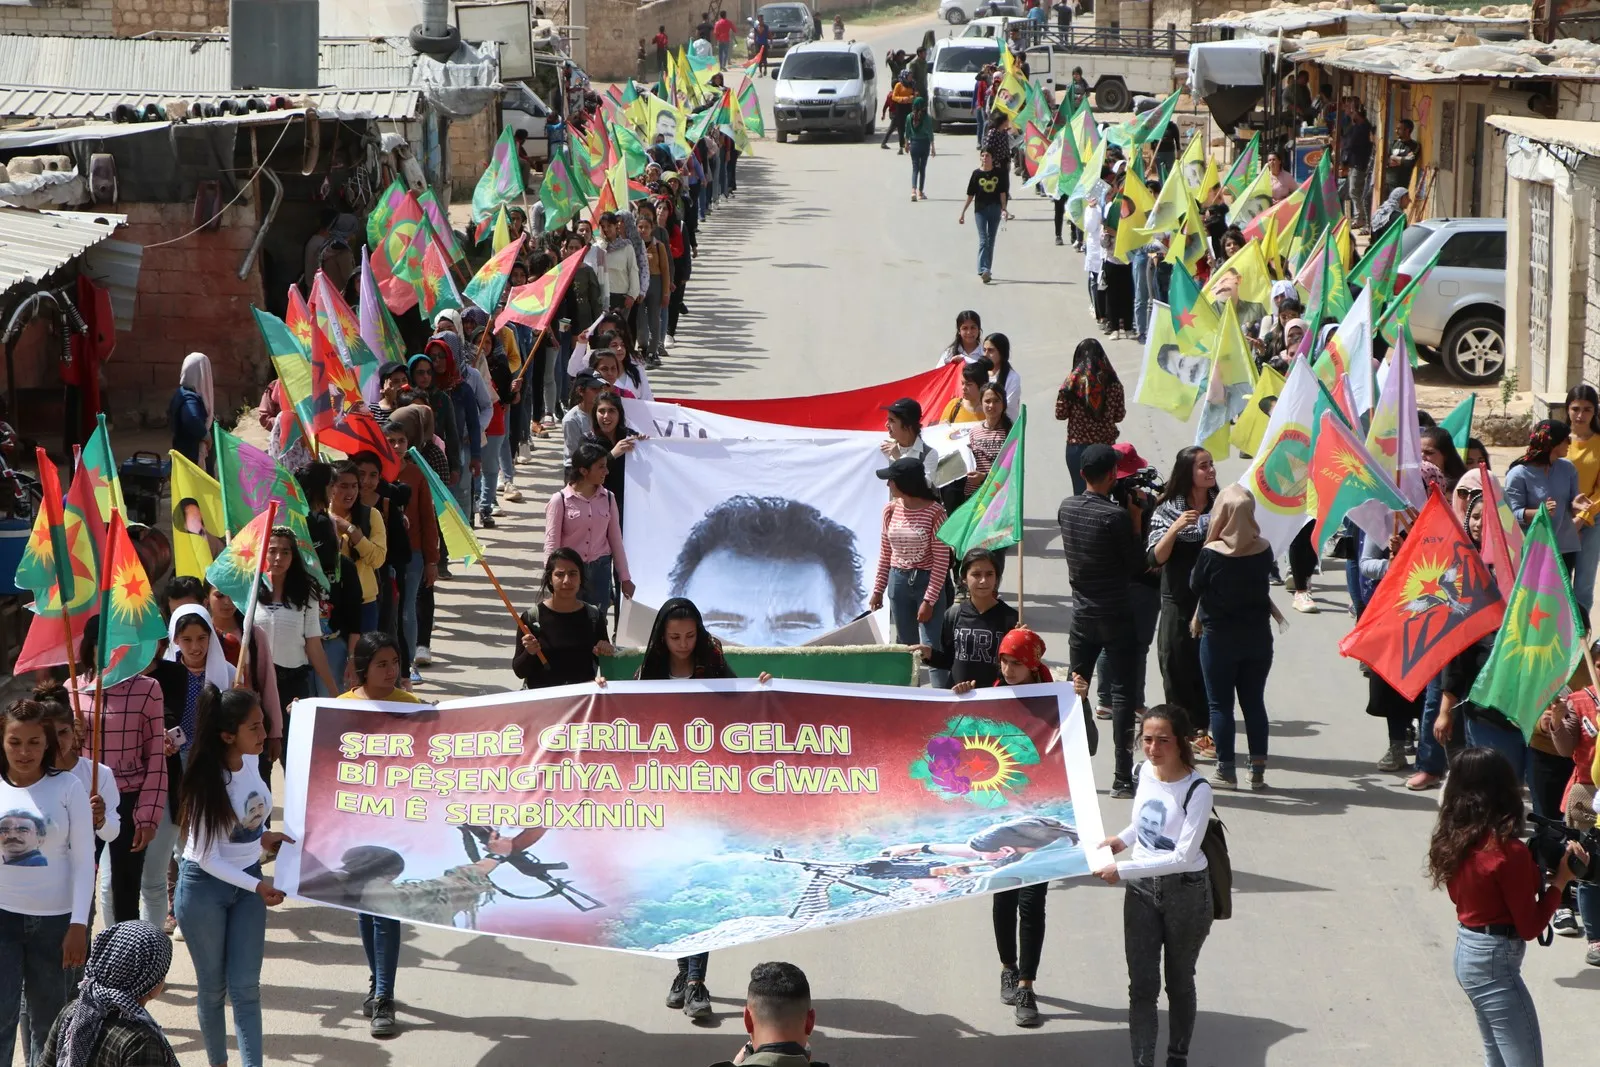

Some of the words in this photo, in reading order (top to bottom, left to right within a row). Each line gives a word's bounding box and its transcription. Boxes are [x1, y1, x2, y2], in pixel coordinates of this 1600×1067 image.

[341, 732, 414, 759] ŞER
[429, 724, 523, 763] ŞERÊ
[539, 718, 678, 752] GERÎLA
[686, 718, 714, 753] Û
[721, 723, 851, 755] GELAN
[336, 790, 395, 817] EM
[404, 796, 428, 821] Ê
